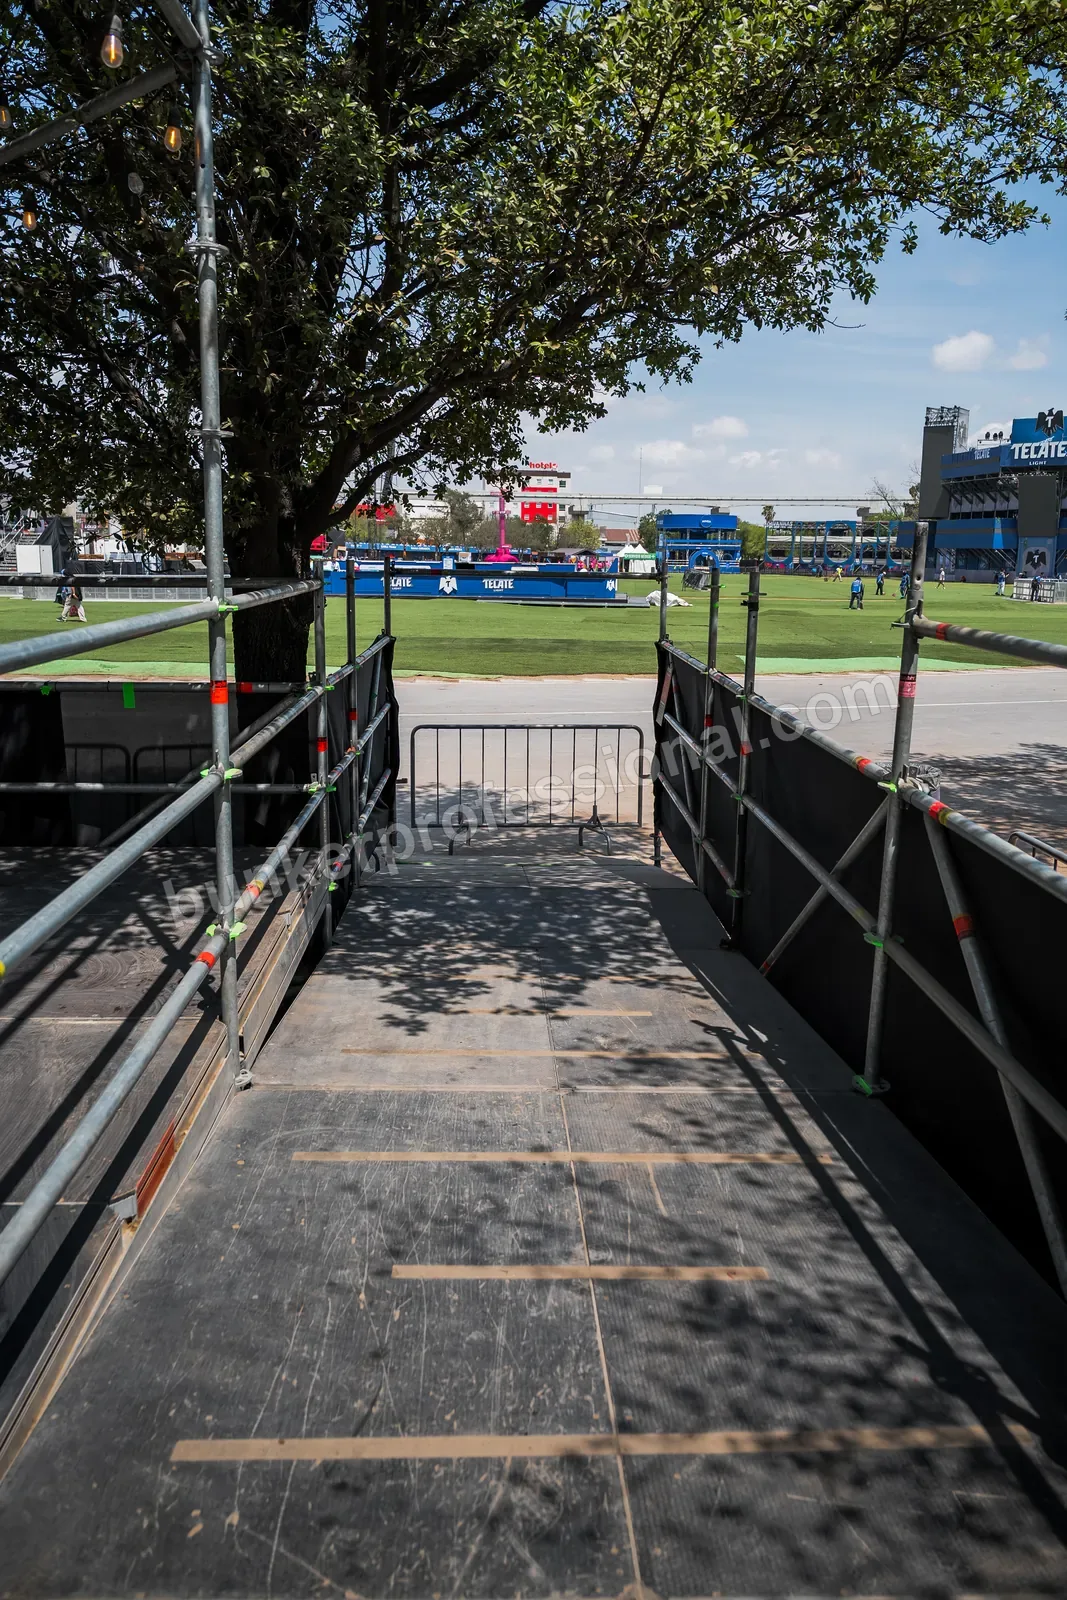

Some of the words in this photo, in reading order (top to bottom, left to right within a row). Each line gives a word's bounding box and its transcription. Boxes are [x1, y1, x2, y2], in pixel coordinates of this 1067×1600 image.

[1010, 440, 1067, 460] TECATE
[529, 462, 552, 470] hotel
[482, 578, 515, 589] TECATE
